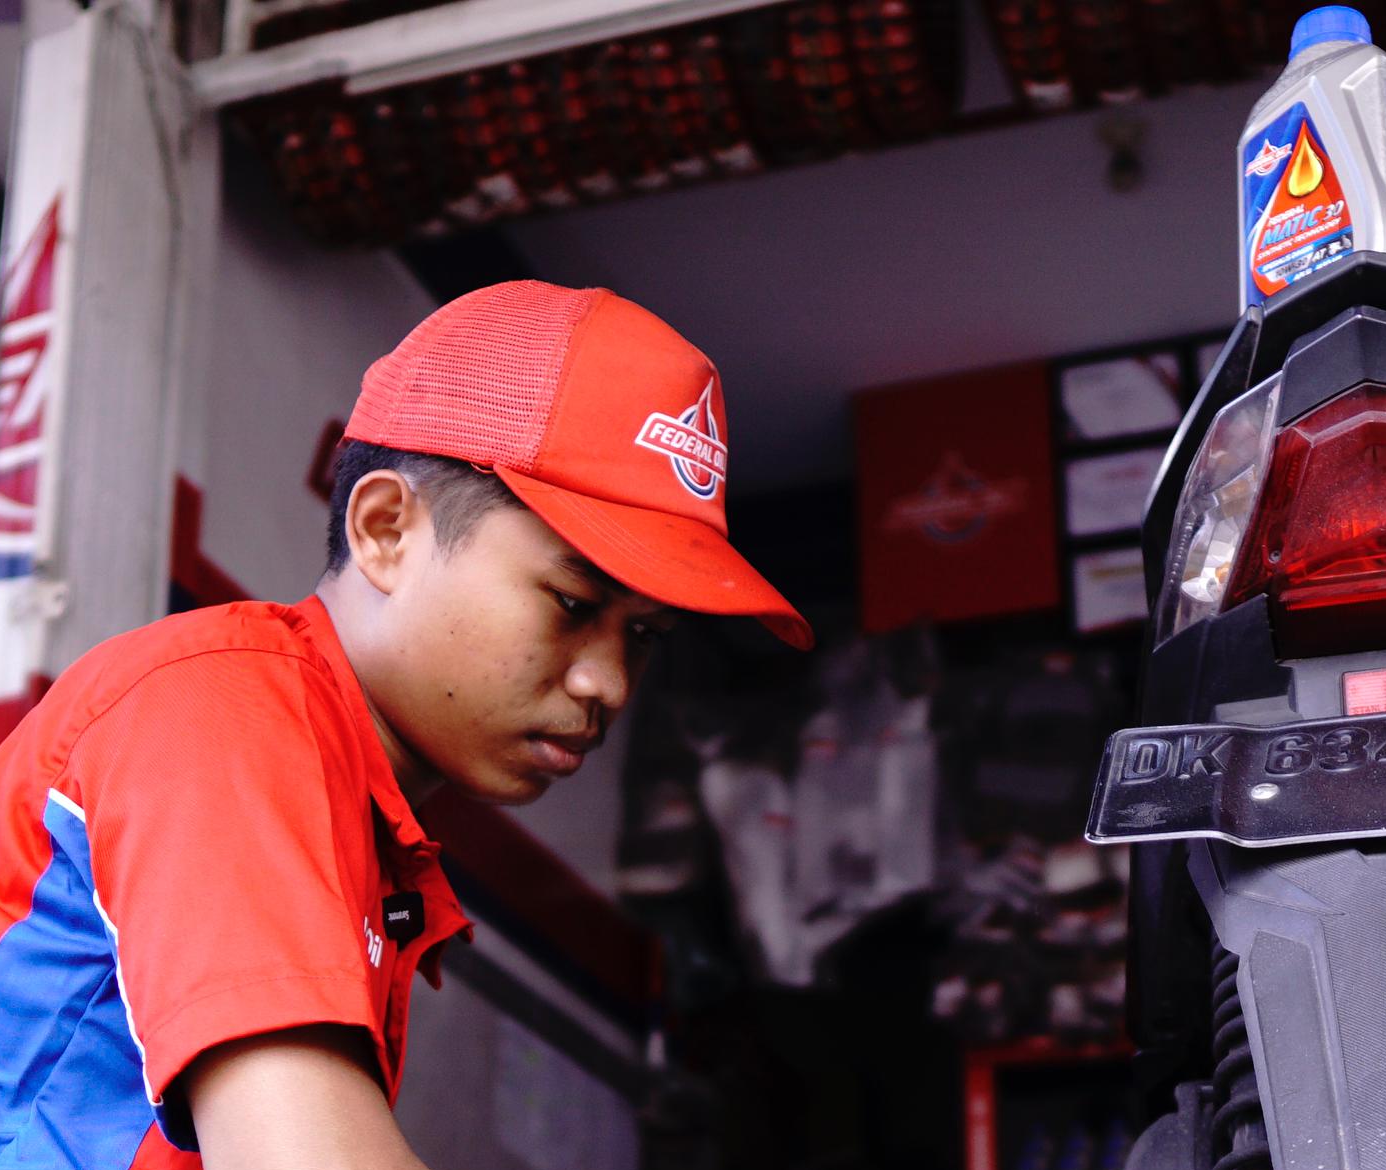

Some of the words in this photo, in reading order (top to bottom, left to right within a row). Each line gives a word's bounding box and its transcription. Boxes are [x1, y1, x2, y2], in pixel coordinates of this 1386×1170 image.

[1260, 205, 1323, 250] MATIC
[1323, 200, 1344, 221] 30
[649, 423, 713, 462] FEDERAL
[1118, 733, 1235, 785] DK
